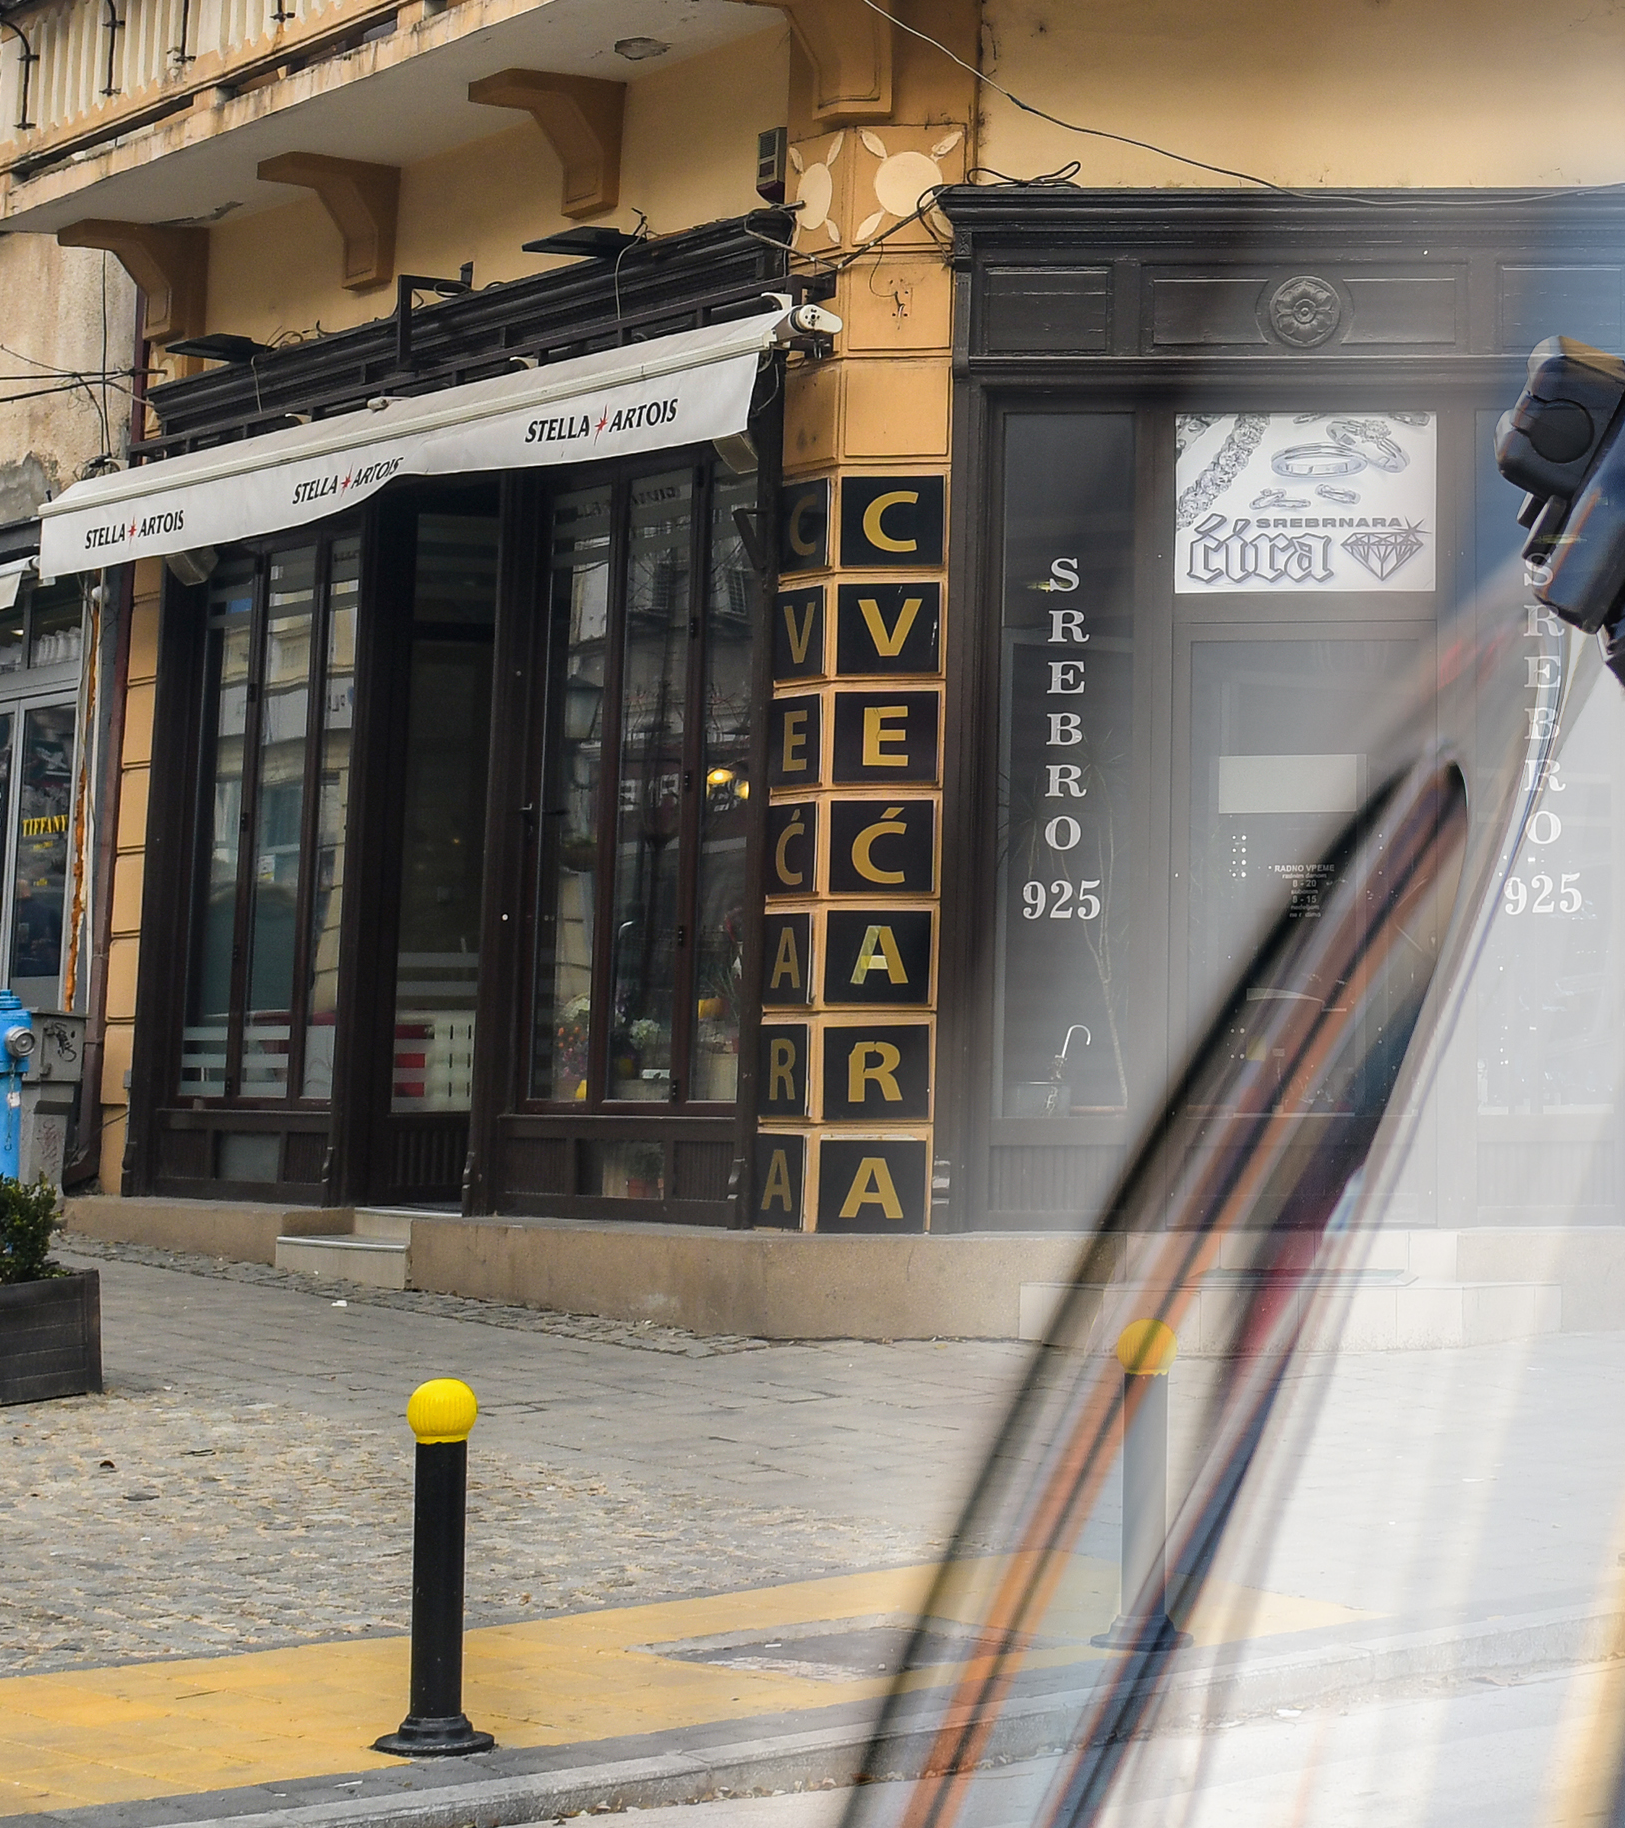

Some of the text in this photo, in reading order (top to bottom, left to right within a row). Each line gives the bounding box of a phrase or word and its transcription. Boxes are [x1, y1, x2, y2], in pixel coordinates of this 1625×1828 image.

[524, 397, 678, 445] STELLA ARTOIS
[292, 456, 404, 506] STELLA ARTOIS
[85, 509, 185, 550] STELLA ARTOIS
[1255, 516, 1403, 529] SREBRNARA
[1044, 556, 1091, 852] SREBRO
[22, 814, 68, 838] TIFFANY
[838, 489, 921, 1220] CVEĆARA
[1275, 864, 1304, 872] RADNO
[1021, 879, 1102, 920] 925
[1504, 872, 1584, 915] 925
